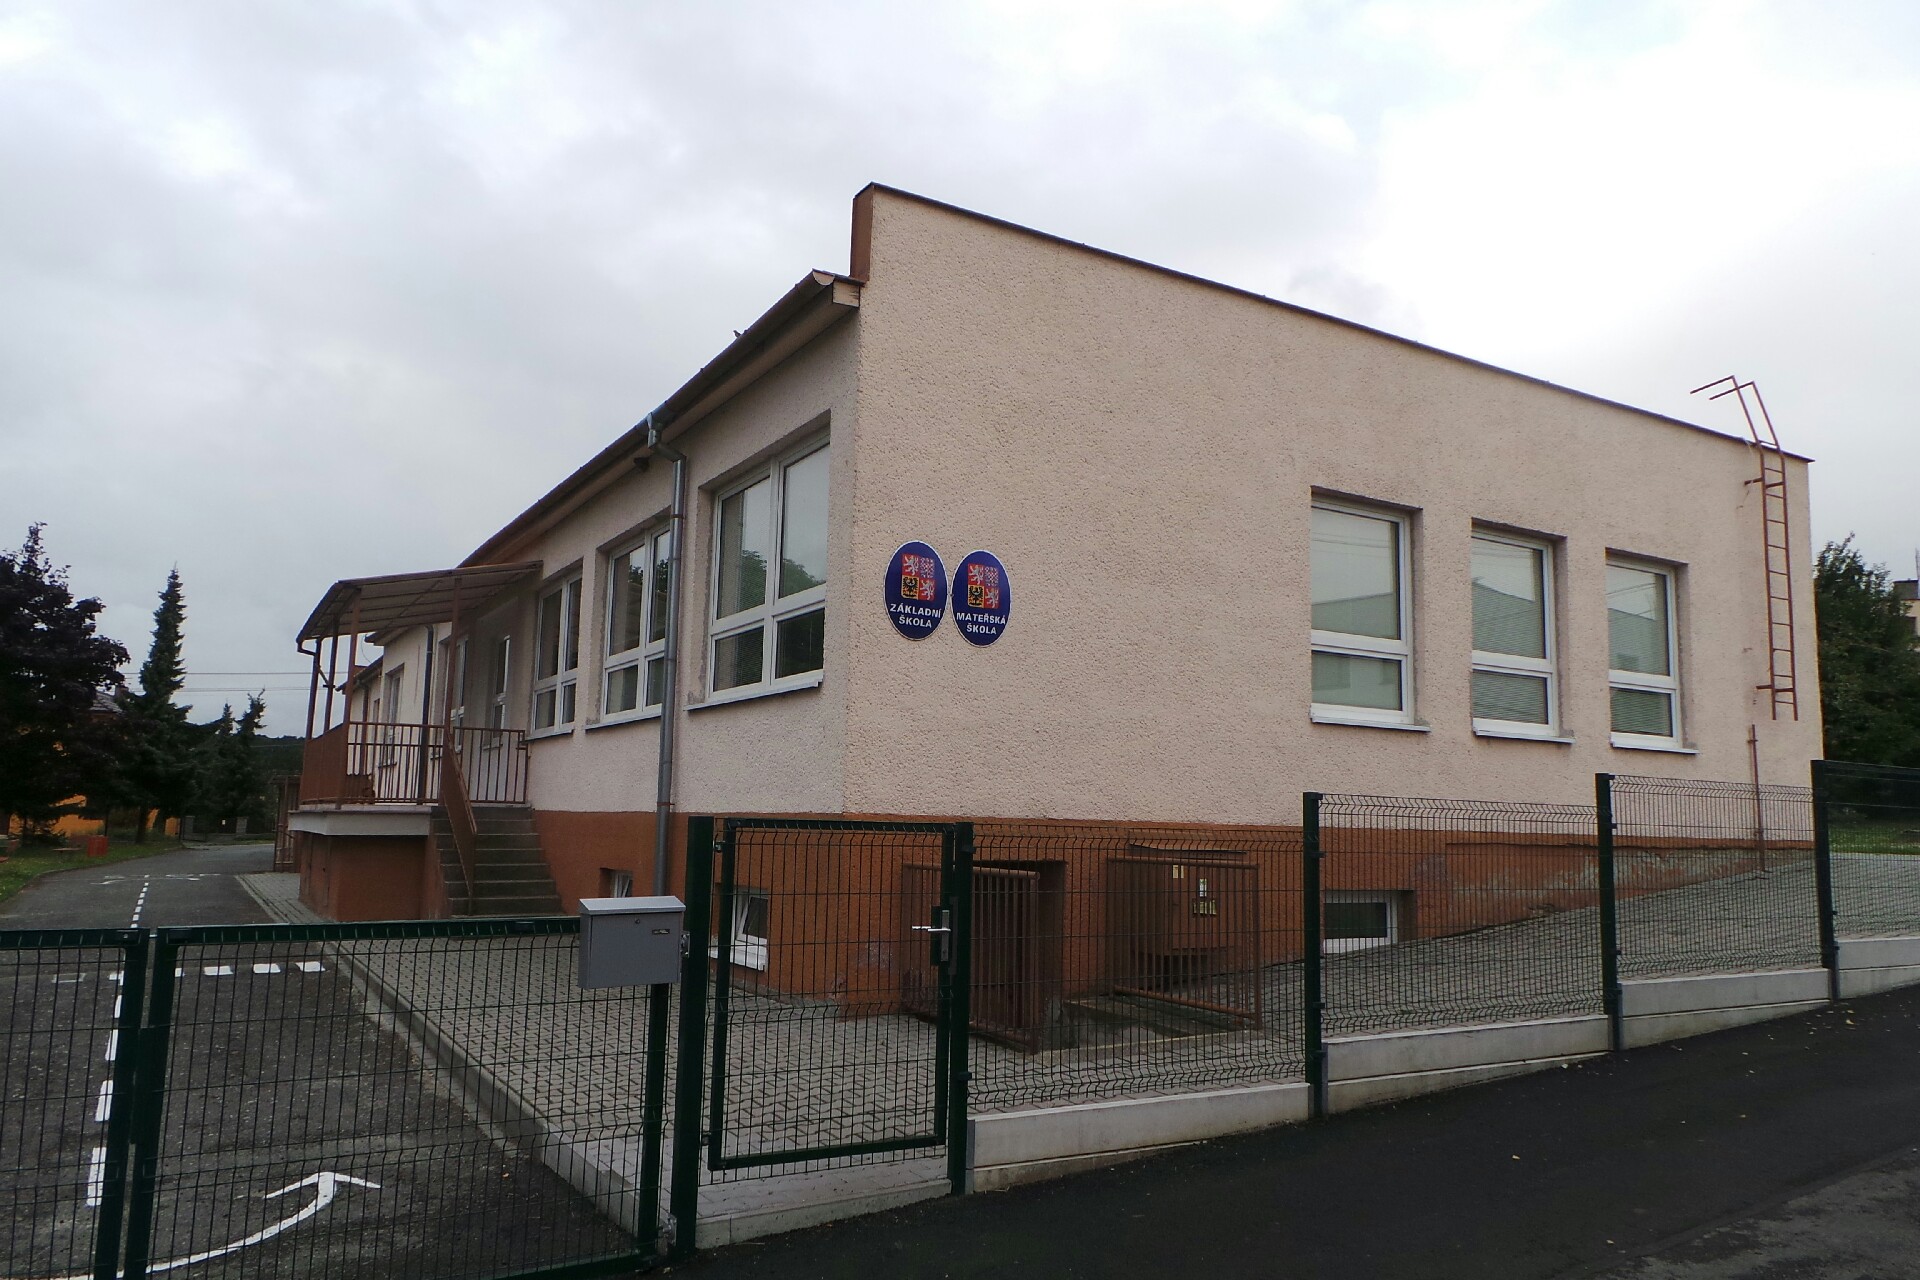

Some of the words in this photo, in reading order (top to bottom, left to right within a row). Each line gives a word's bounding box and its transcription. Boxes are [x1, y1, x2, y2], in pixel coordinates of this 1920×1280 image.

[890, 603, 942, 618] ZÁKLADNÍ
[898, 616, 932, 628] ŠKOLA
[956, 612, 1006, 625] MATEŘSKÁ
[966, 623, 997, 635] ŠKOLA
